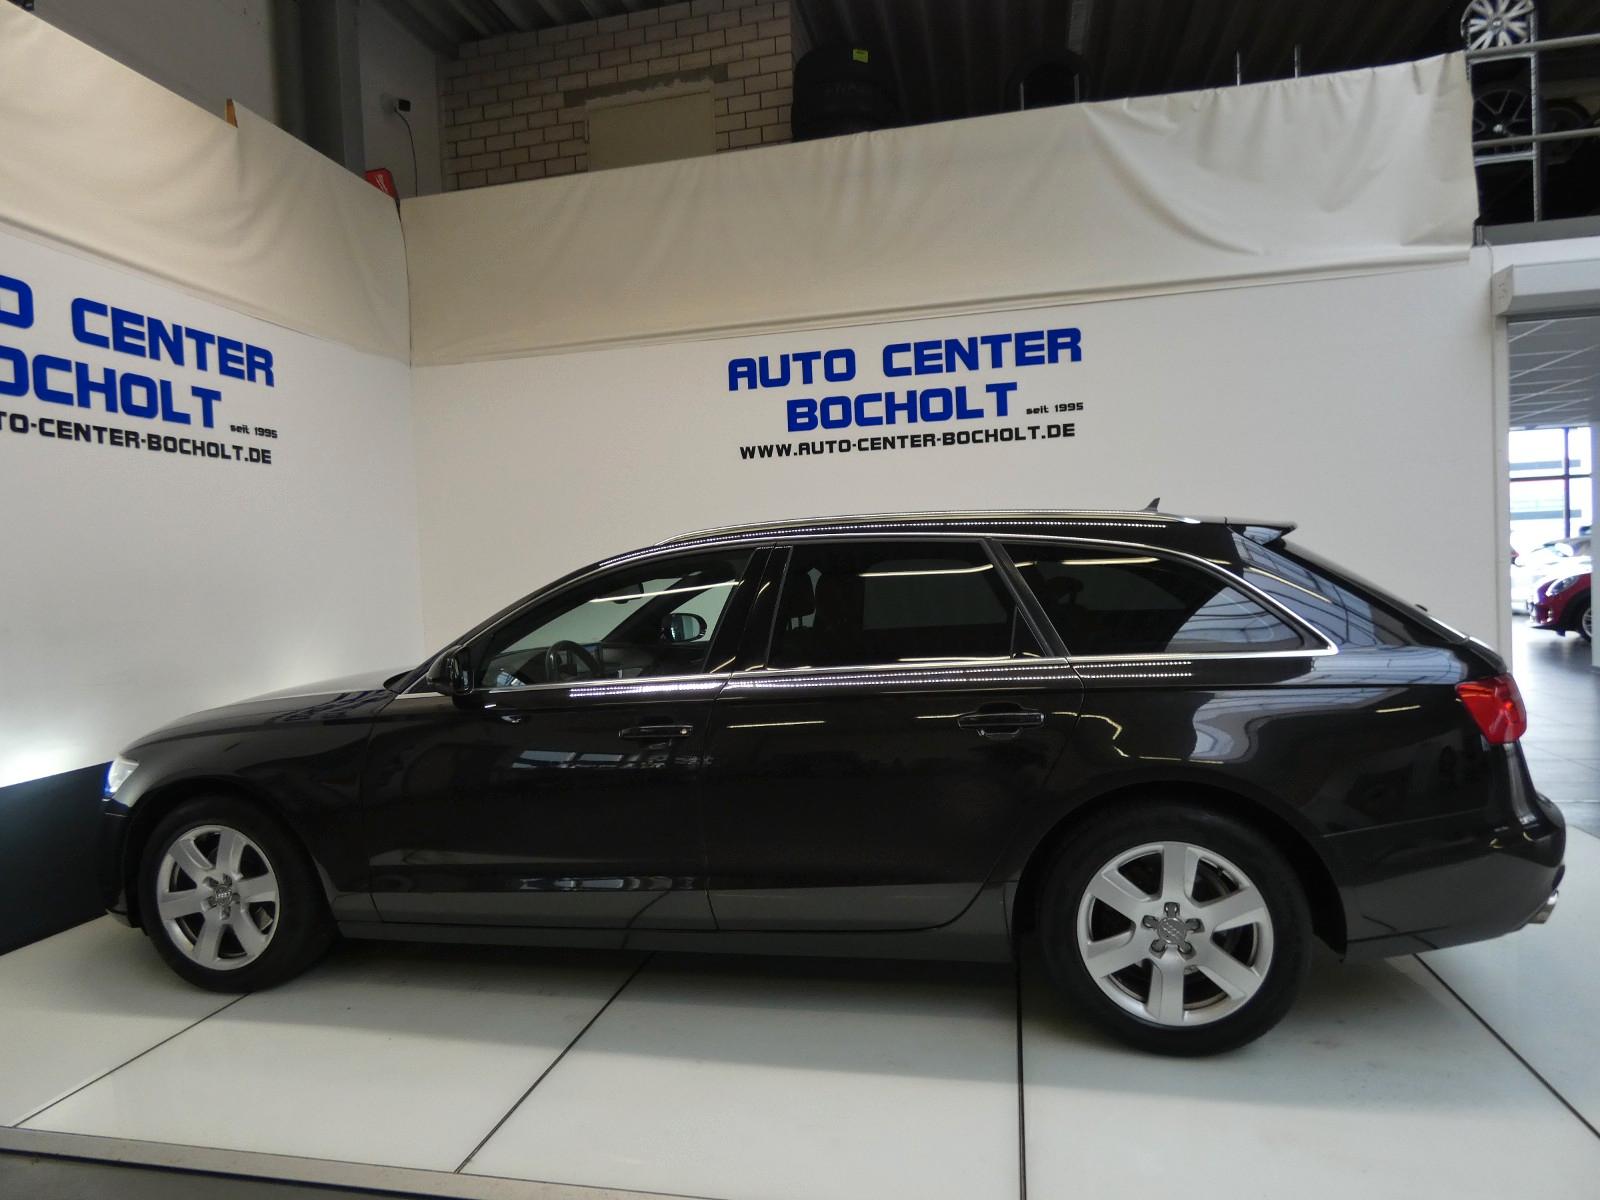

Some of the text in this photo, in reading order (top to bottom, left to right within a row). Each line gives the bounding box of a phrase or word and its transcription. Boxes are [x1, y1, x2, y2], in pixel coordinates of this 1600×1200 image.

[71, 297, 275, 387] CENTER
[728, 327, 1082, 391] AUTO CENTER
[786, 382, 1018, 432] BOCHOLT
[1025, 401, 1084, 415] seit 1995
[230, 424, 278, 439] seit 1995
[739, 422, 1076, 460] WWW.AUTO-CENTER-BOCHOLT.DE
